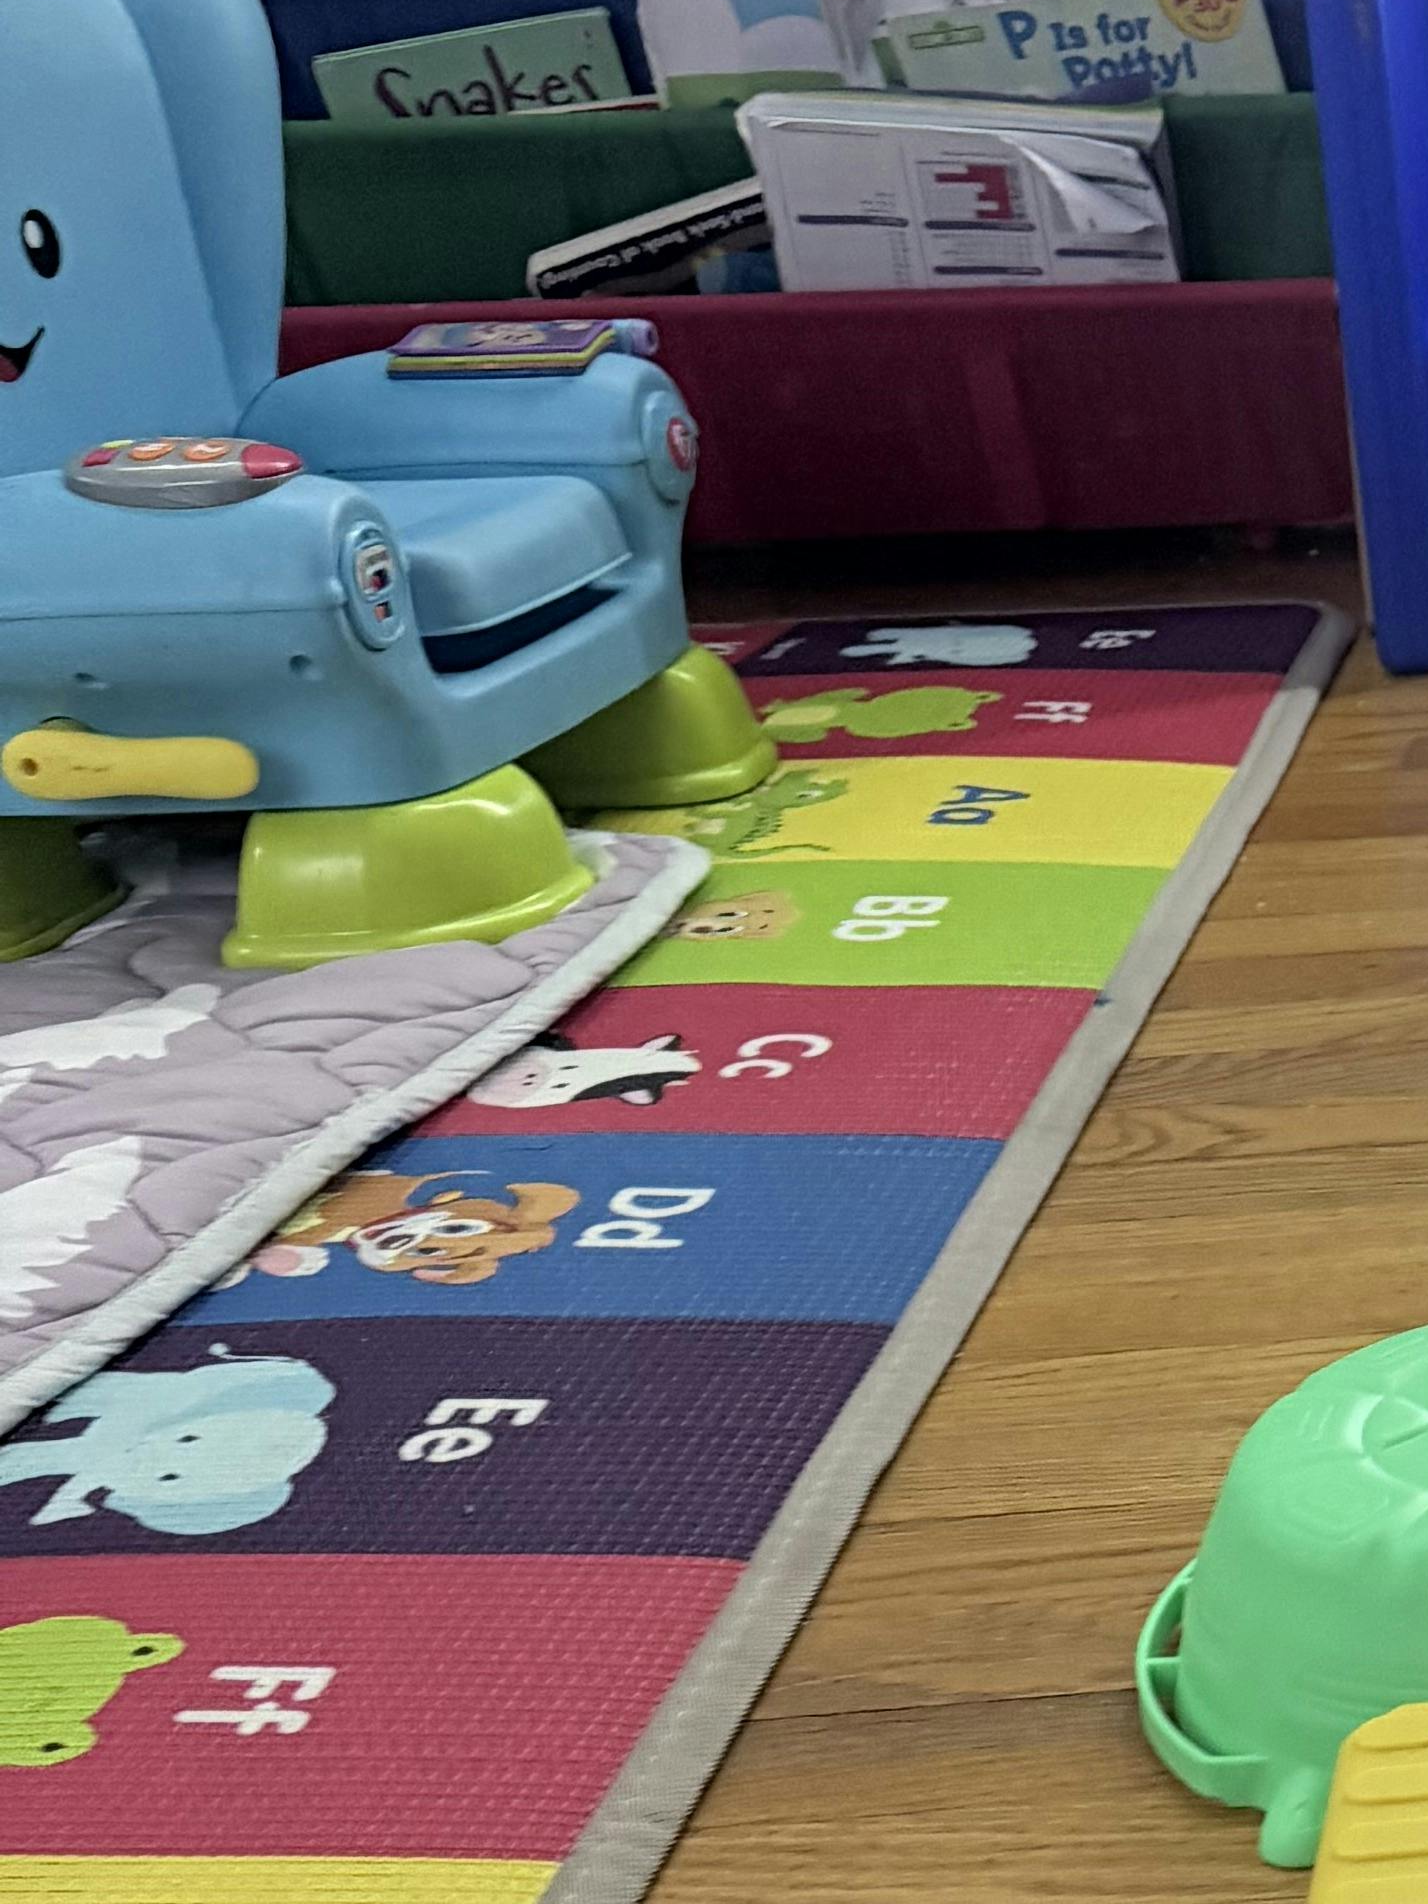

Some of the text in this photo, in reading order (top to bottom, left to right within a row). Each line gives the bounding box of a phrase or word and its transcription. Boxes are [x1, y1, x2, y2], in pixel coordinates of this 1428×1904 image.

[997, 11, 1038, 60] P
[1097, 13, 1152, 44] for
[1013, 698, 1092, 723] Ff
[925, 783, 1033, 827] Aa
[830, 894, 951, 943] Bb
[717, 1032, 834, 1082] Cc
[572, 1184, 717, 1250] Dd
[397, 1396, 551, 1466] Ee
[172, 1663, 338, 1737] Ff
